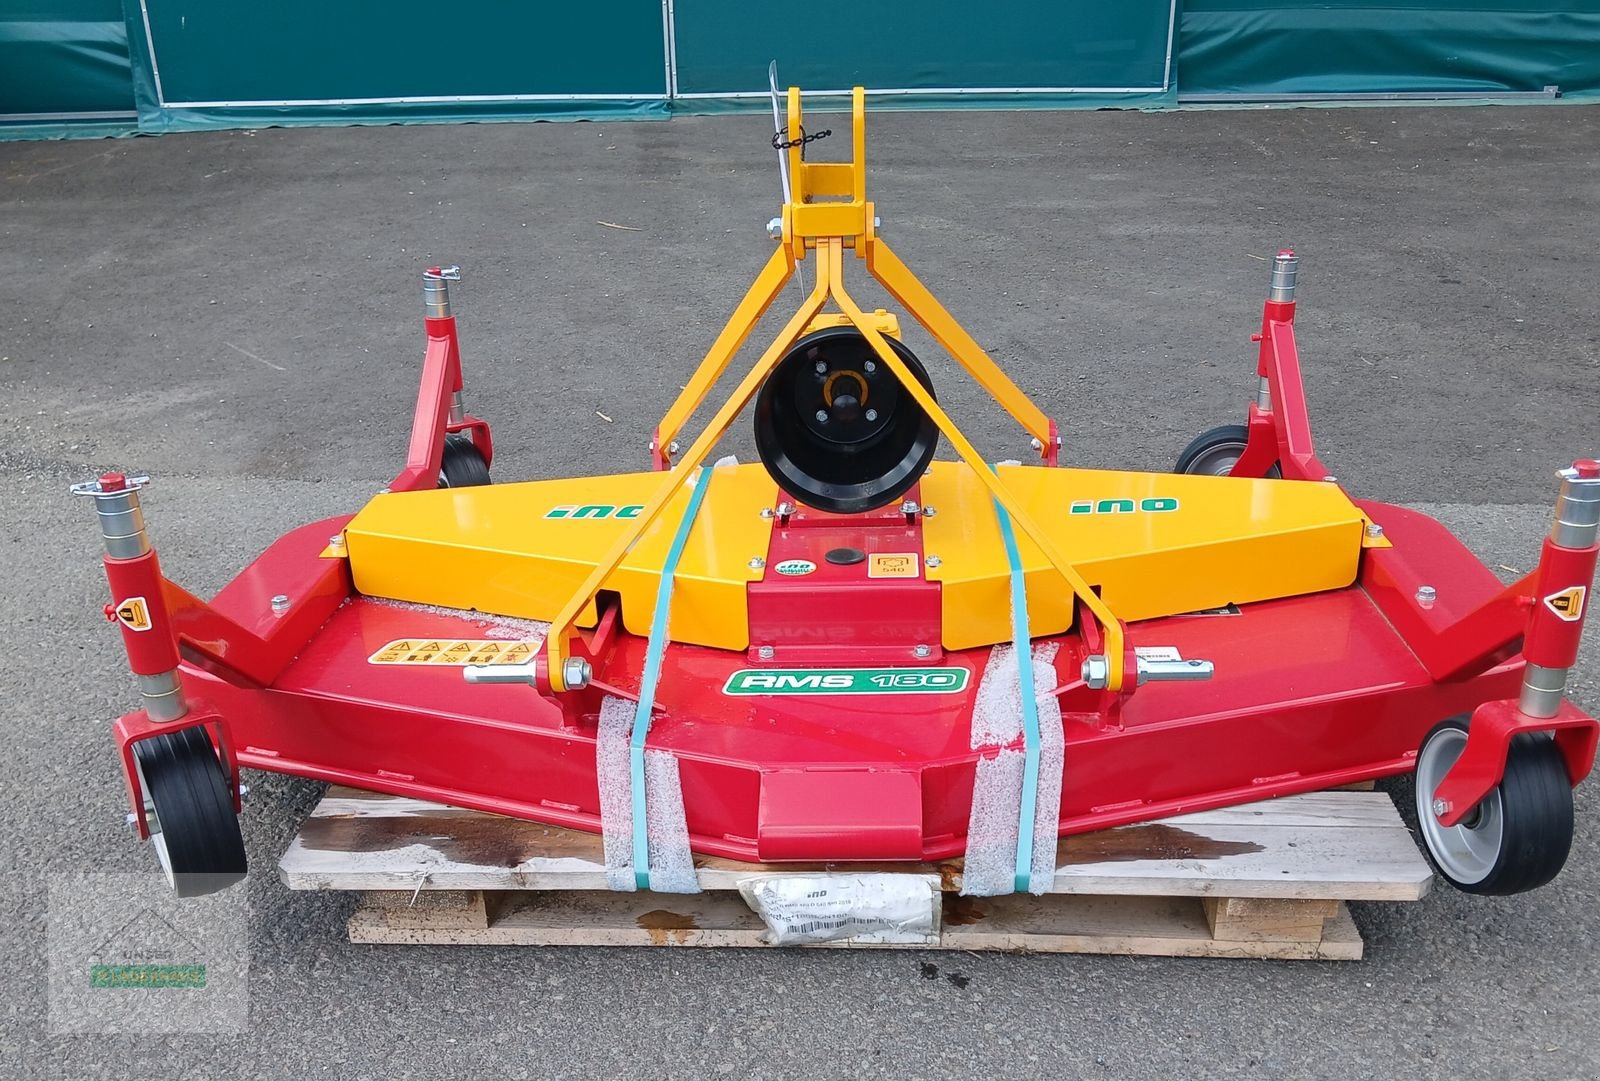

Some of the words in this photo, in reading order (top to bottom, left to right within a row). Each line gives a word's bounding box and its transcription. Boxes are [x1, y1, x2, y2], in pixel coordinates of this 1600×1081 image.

[1070, 498, 1179, 514] ino
[740, 675, 854, 688] RMS
[870, 673, 958, 687] 180
